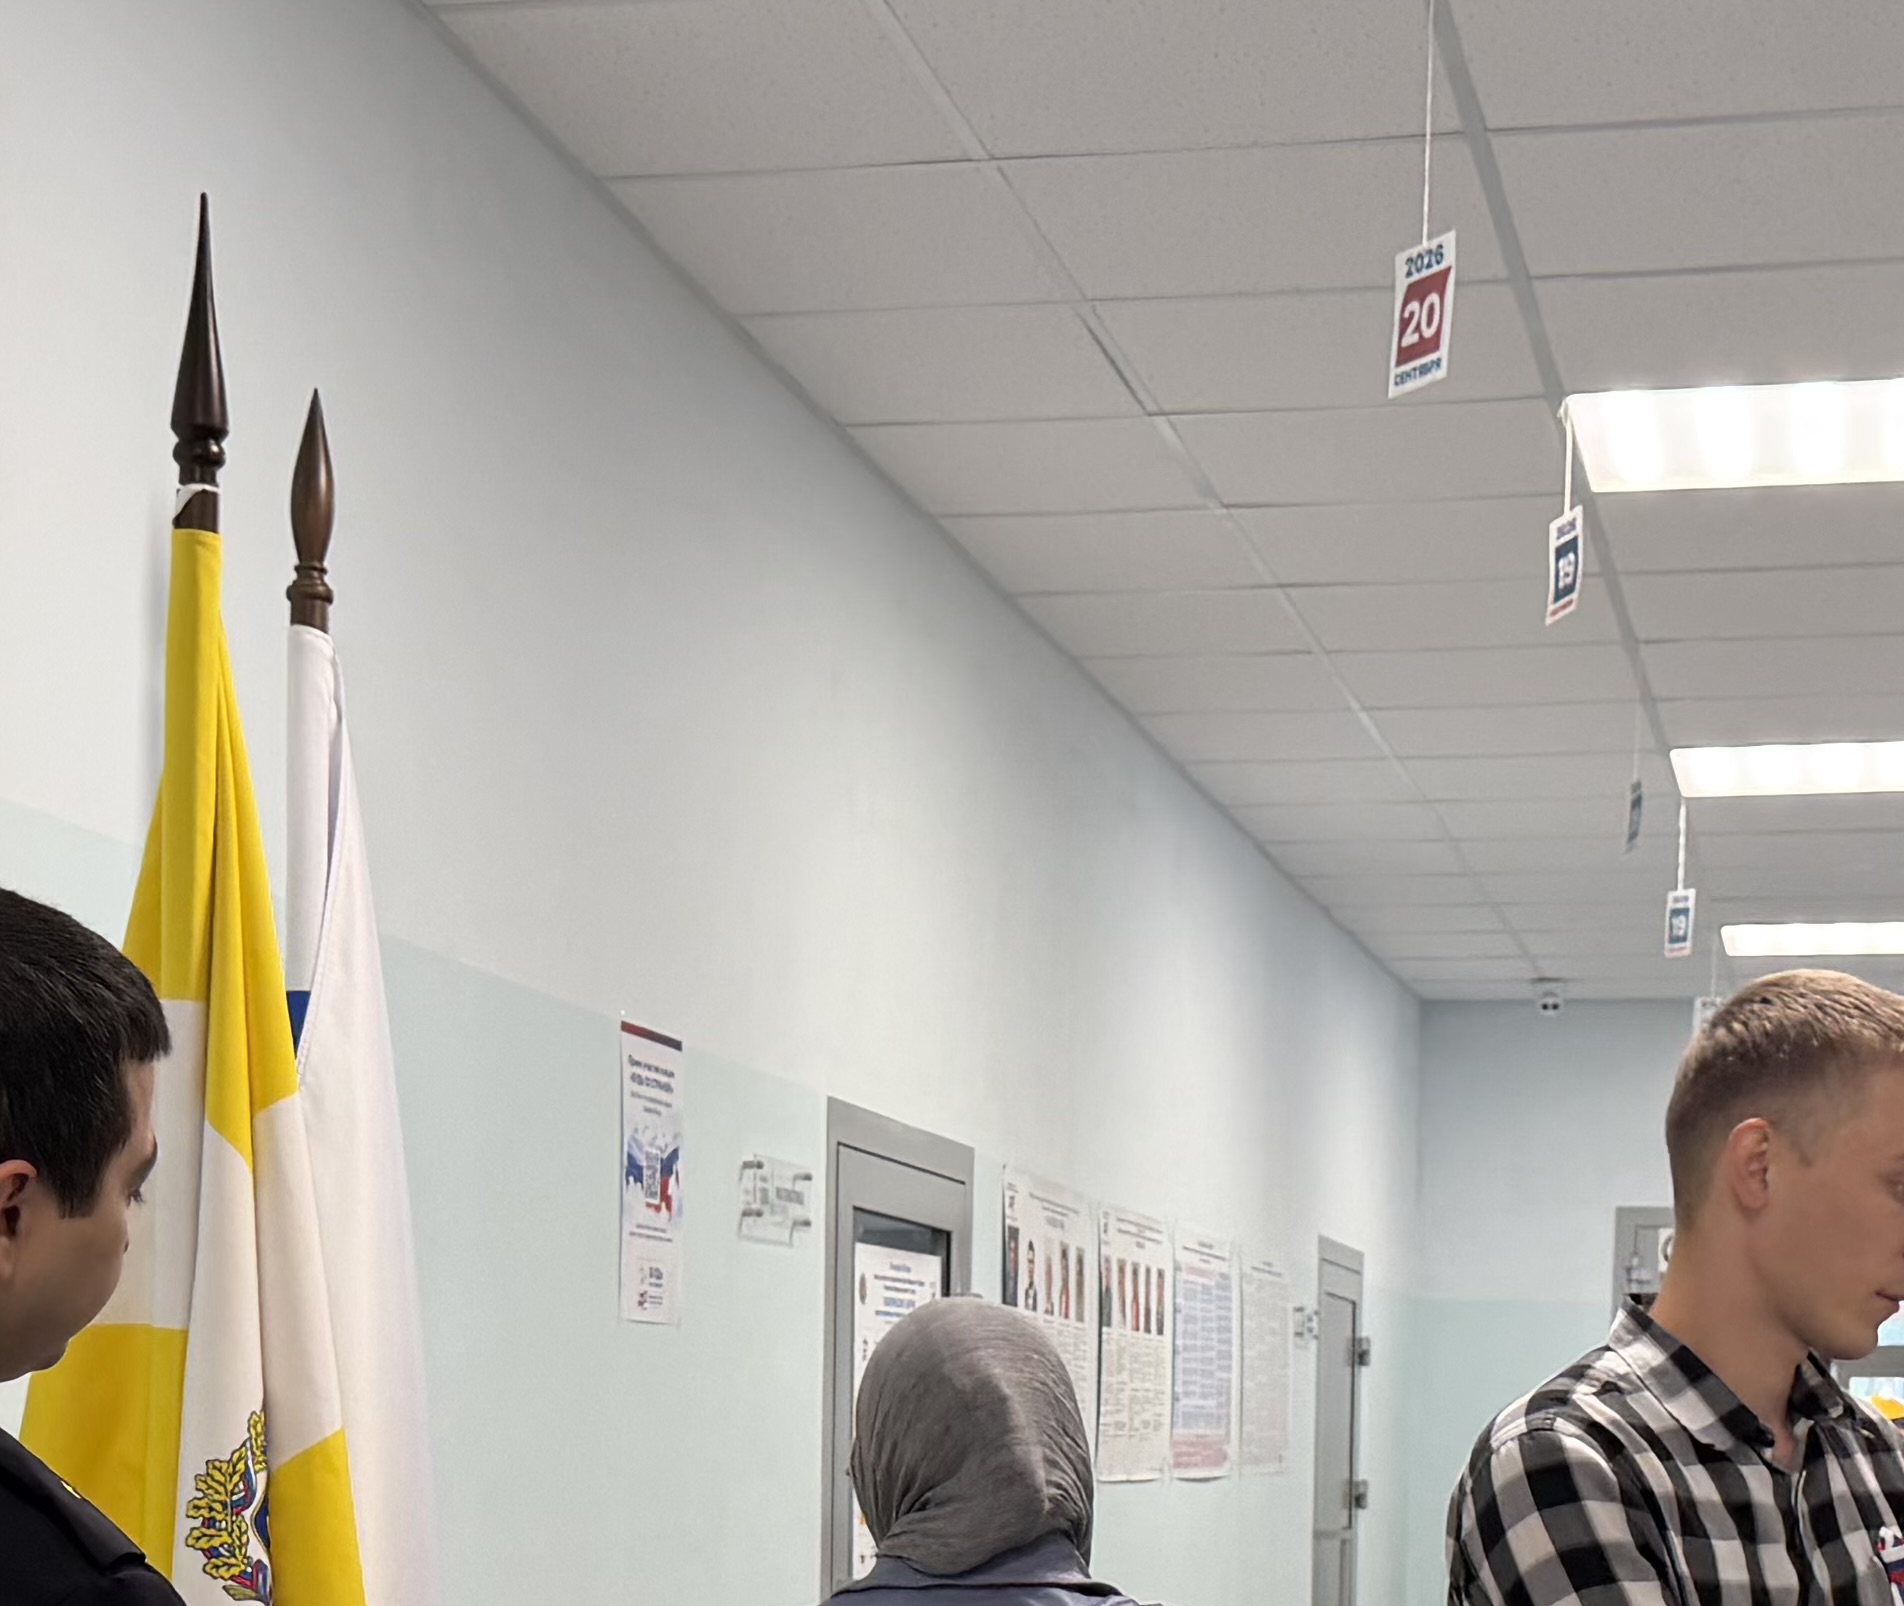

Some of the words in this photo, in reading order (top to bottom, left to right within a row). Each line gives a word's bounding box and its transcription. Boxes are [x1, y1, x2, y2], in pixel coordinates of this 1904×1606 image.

[1405, 243, 1444, 279] 2026
[1400, 292, 1441, 348] 20
[1394, 357, 1442, 387] СЕНТЯБРЯ
